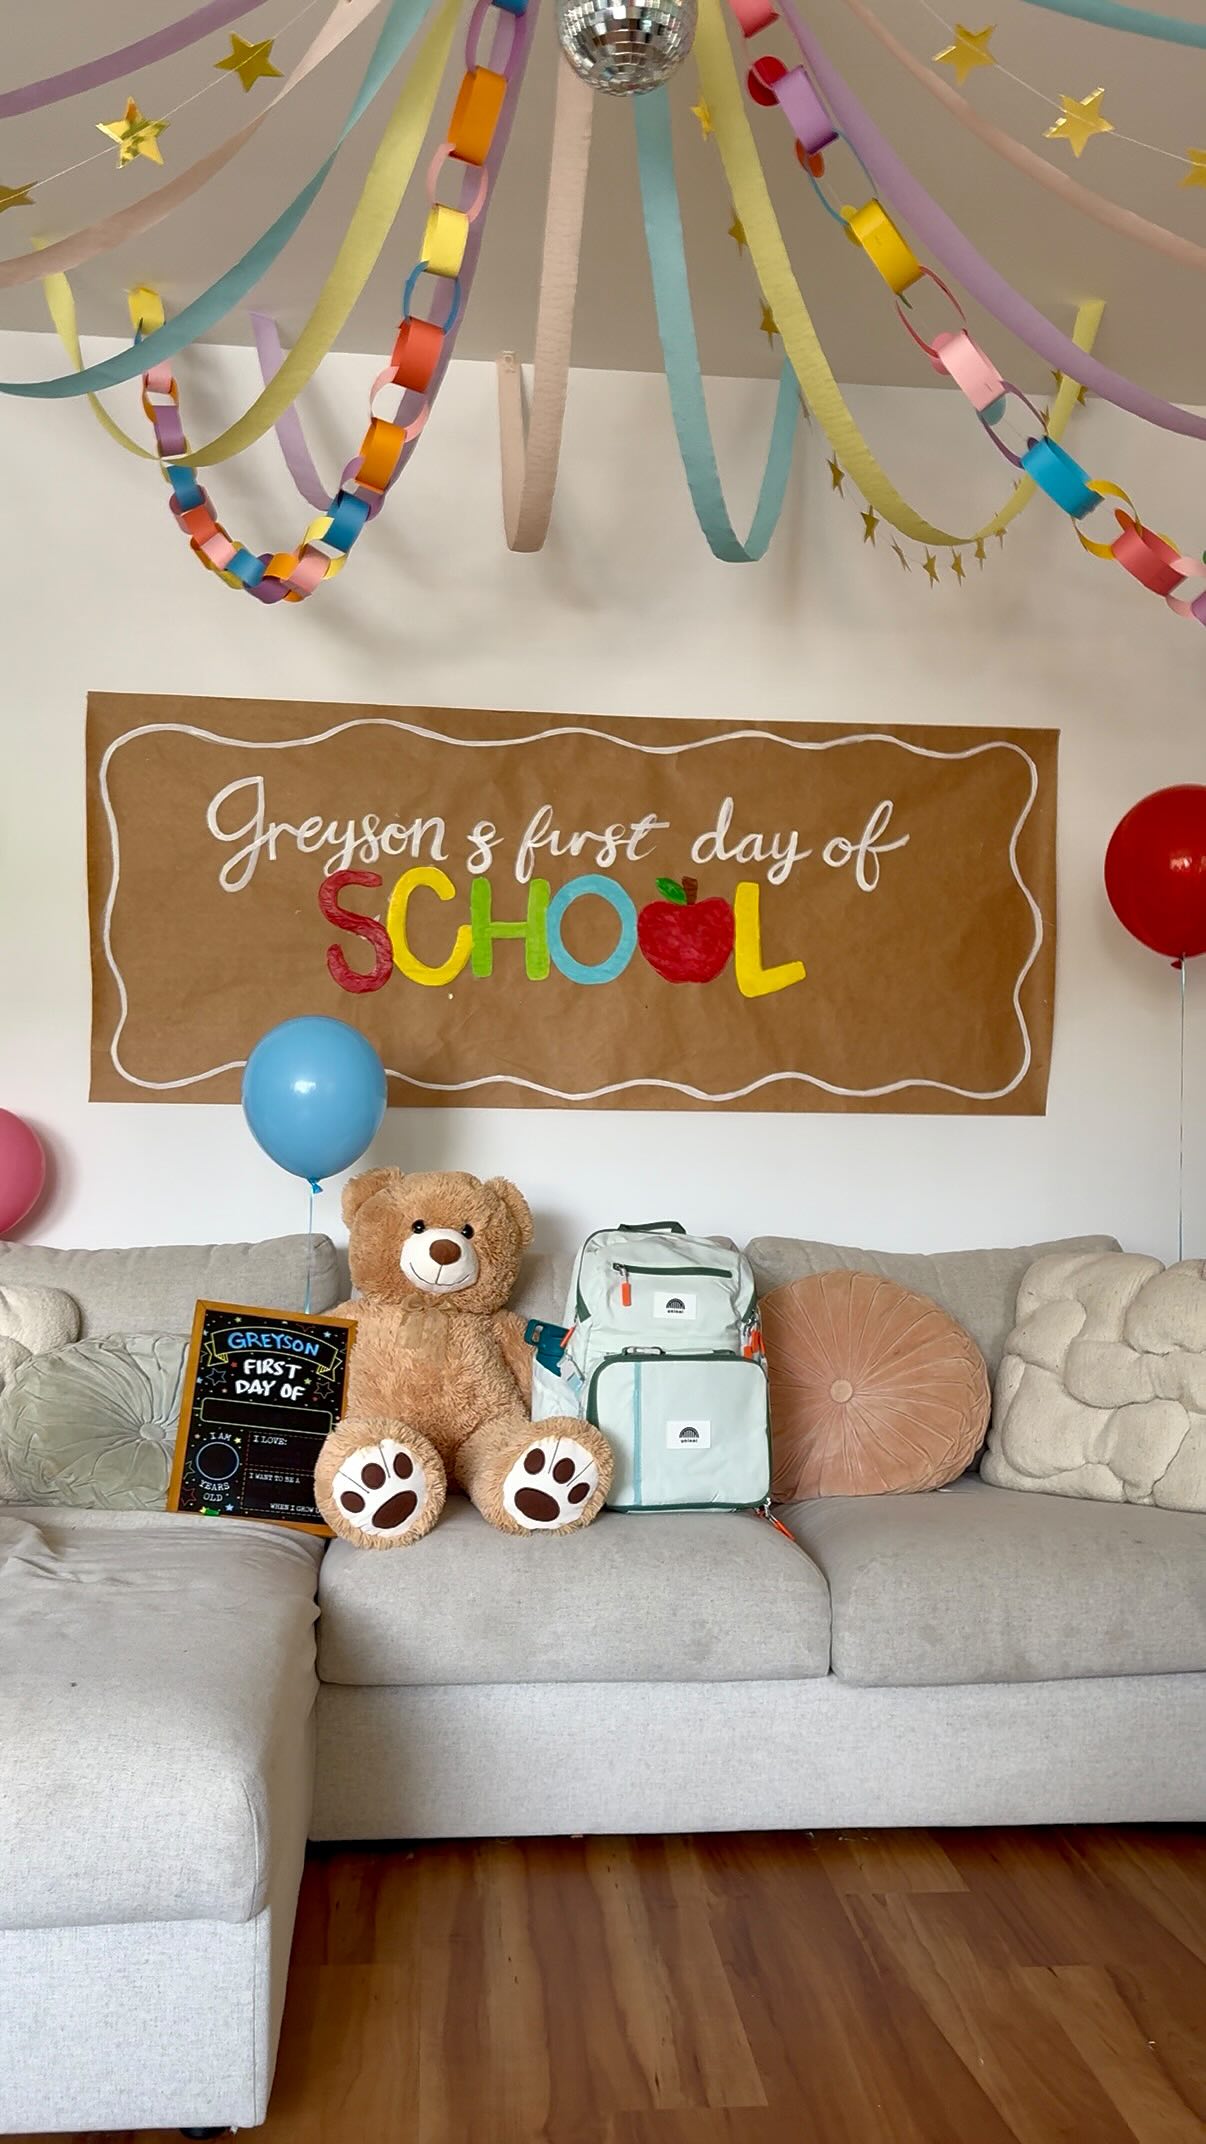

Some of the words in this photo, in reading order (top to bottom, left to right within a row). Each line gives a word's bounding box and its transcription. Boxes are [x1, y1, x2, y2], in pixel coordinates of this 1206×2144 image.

[206, 775, 449, 892] Greyson
[515, 804, 670, 884] first
[691, 796, 812, 886] day
[822, 799, 910, 892] of
[227, 1331, 319, 1357] GREYSON
[243, 1358, 302, 1379] FIRST
[235, 1379, 276, 1397] DAY
[280, 1383, 306, 1401] OF
[218, 1432, 232, 1441] AM
[253, 1434, 260, 1443] I
[261, 1436, 288, 1446] LOVE:
[254, 1472, 273, 1481] WANT
[274, 1474, 284, 1483] TO
[284, 1475, 294, 1484] BE
[199, 1480, 230, 1491] YEARS
[202, 1492, 223, 1502] OLD
[270, 1502, 290, 1512] WHEN
[295, 1505, 314, 1513] GROW
